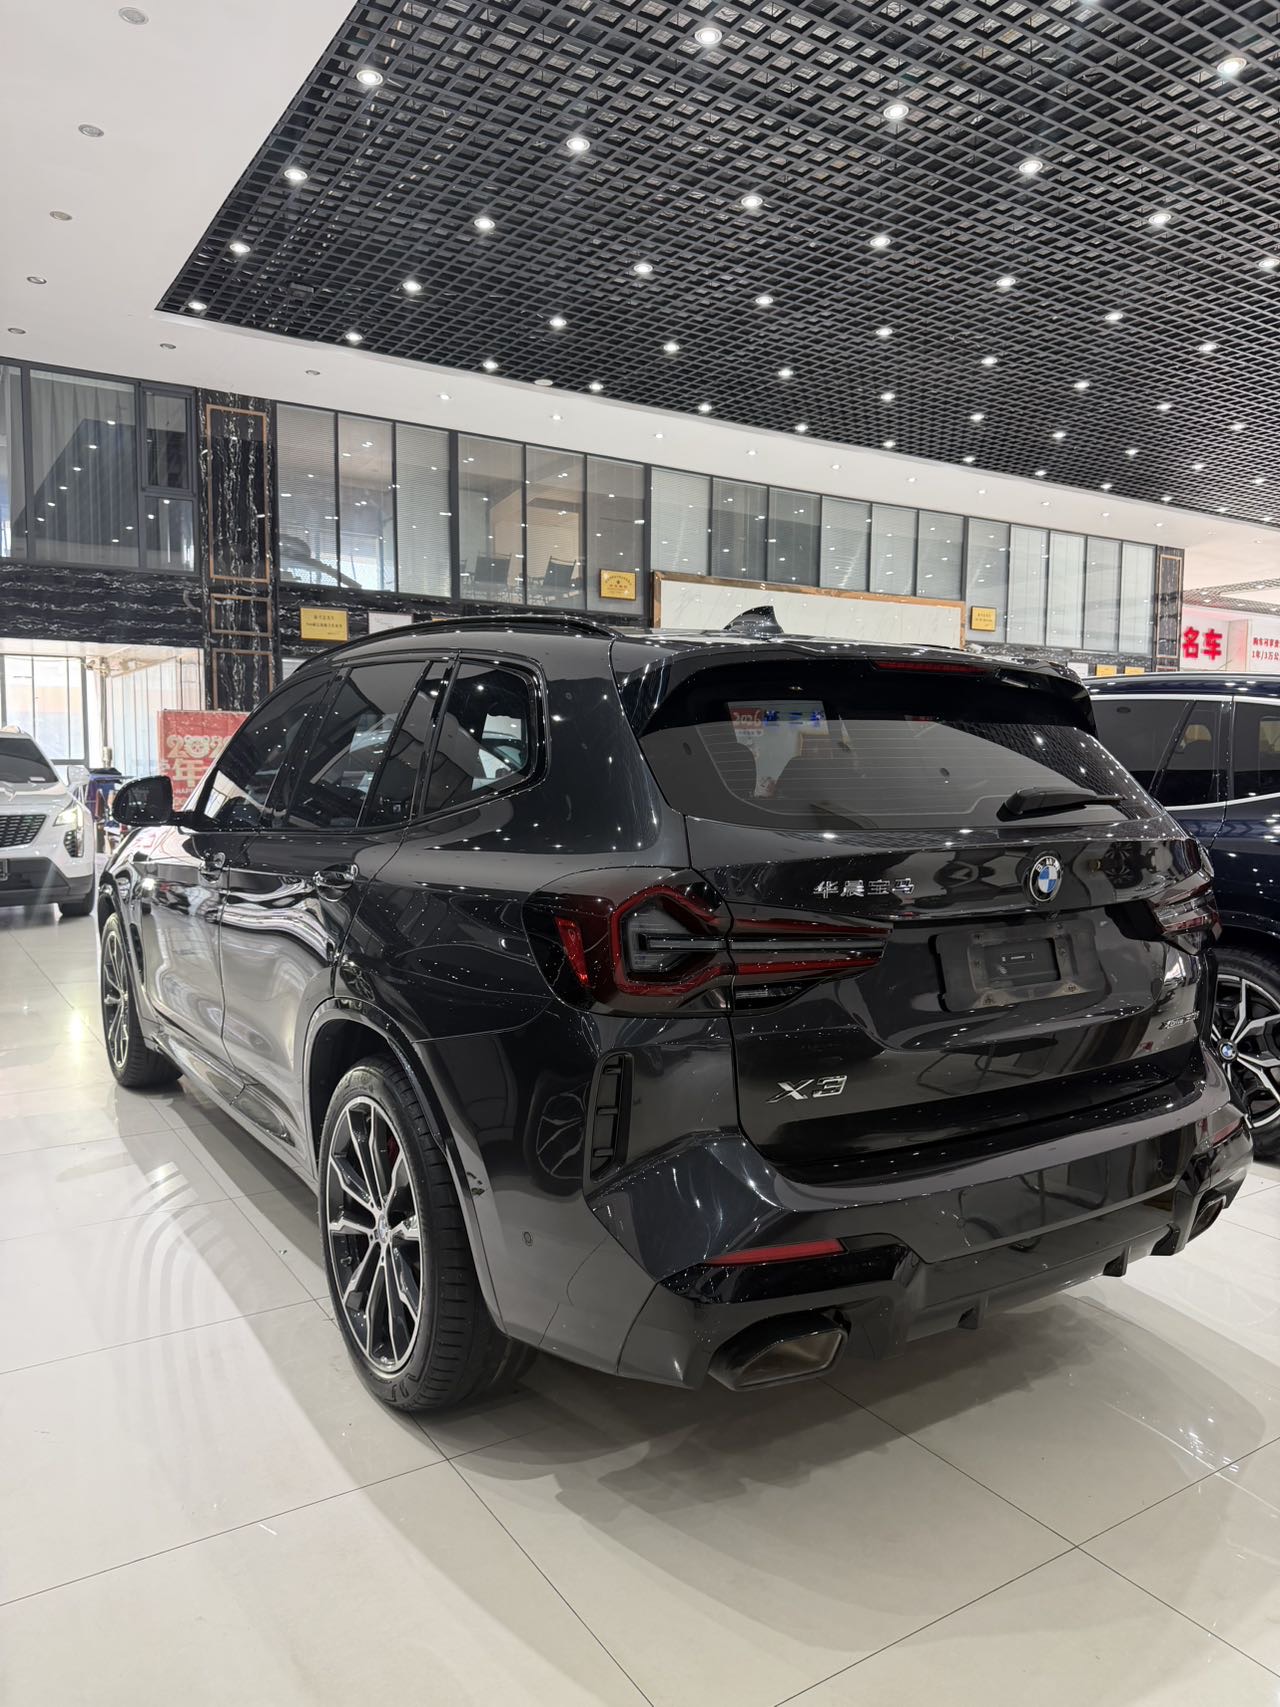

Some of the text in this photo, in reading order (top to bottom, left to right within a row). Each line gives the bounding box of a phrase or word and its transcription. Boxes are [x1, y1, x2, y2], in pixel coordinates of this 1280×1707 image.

[1182, 626, 1223, 661] 名车
[1251, 650, 1280, 661] 1年/3万公
[813, 878, 914, 899] 华晨宝马
[766, 1075, 848, 1103] X3
